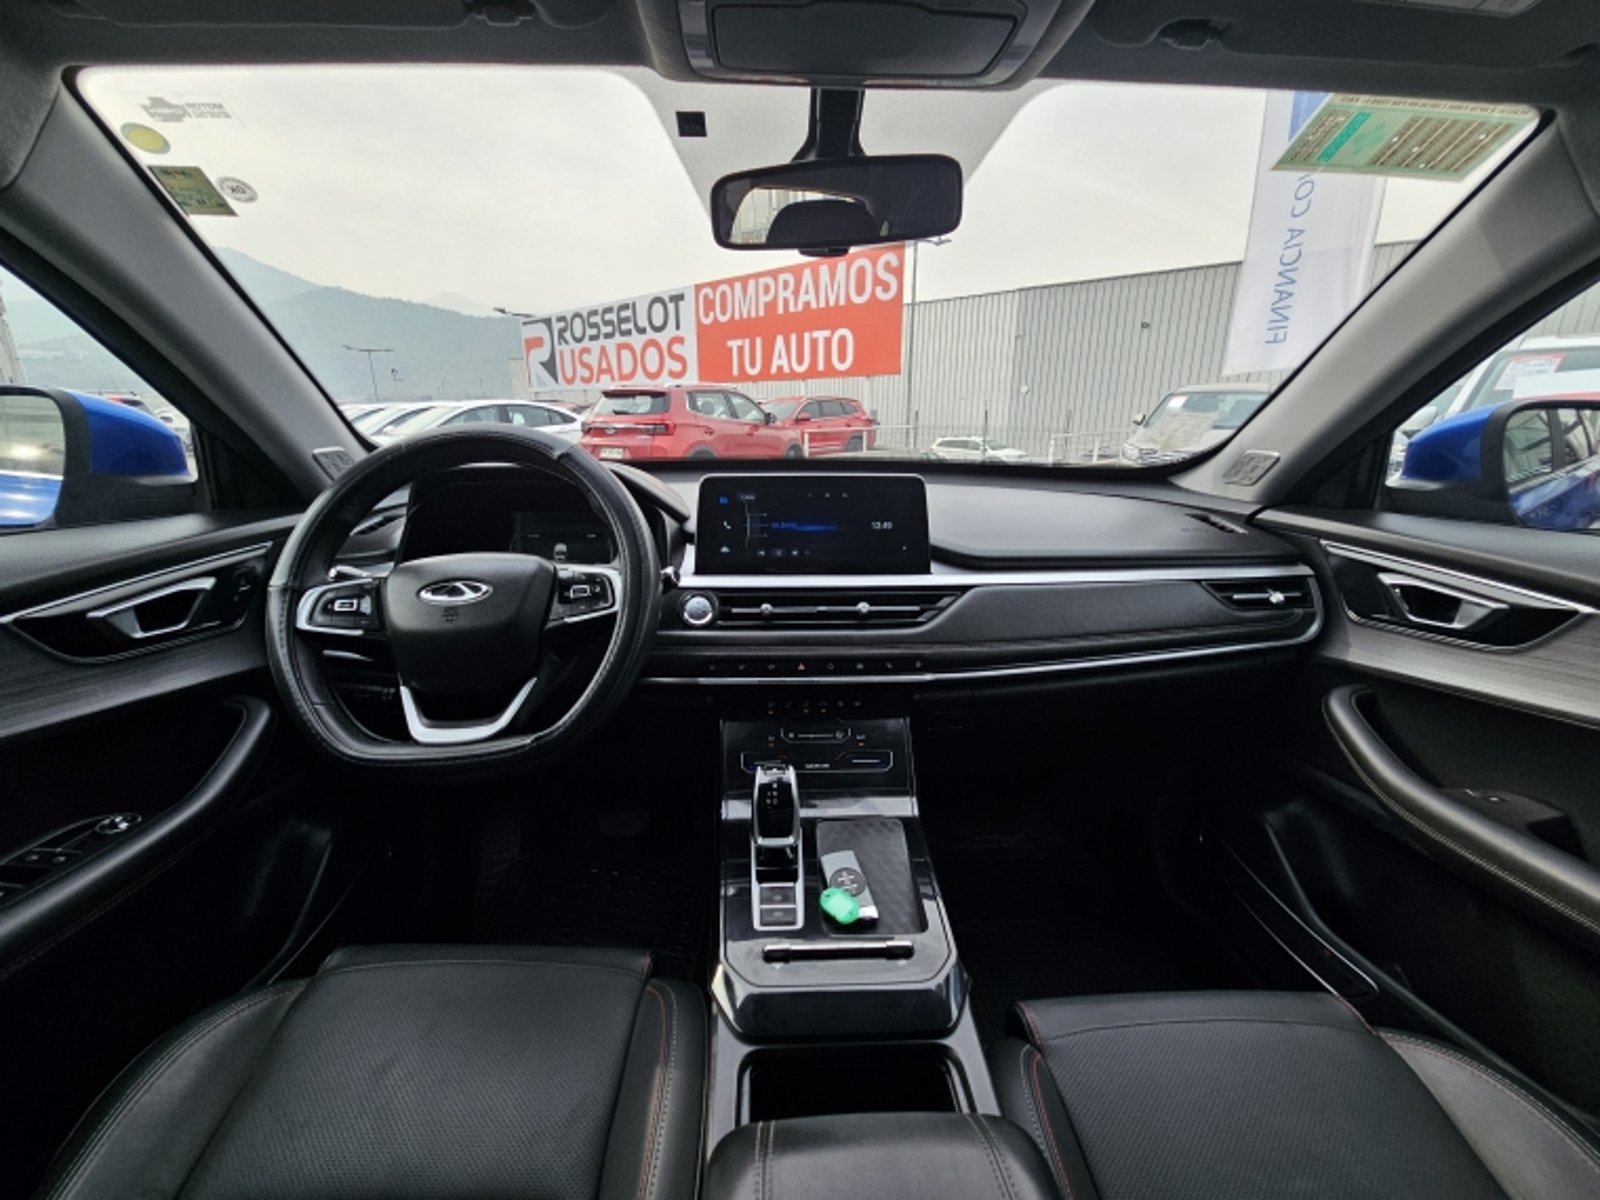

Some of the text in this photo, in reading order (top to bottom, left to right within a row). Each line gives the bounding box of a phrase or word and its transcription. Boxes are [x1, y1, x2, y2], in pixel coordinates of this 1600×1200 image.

[699, 253, 899, 325] COMPRAMOS
[556, 293, 685, 346] ROSSELOT
[560, 335, 688, 386] USADOS
[727, 328, 854, 376] TU AUTO
